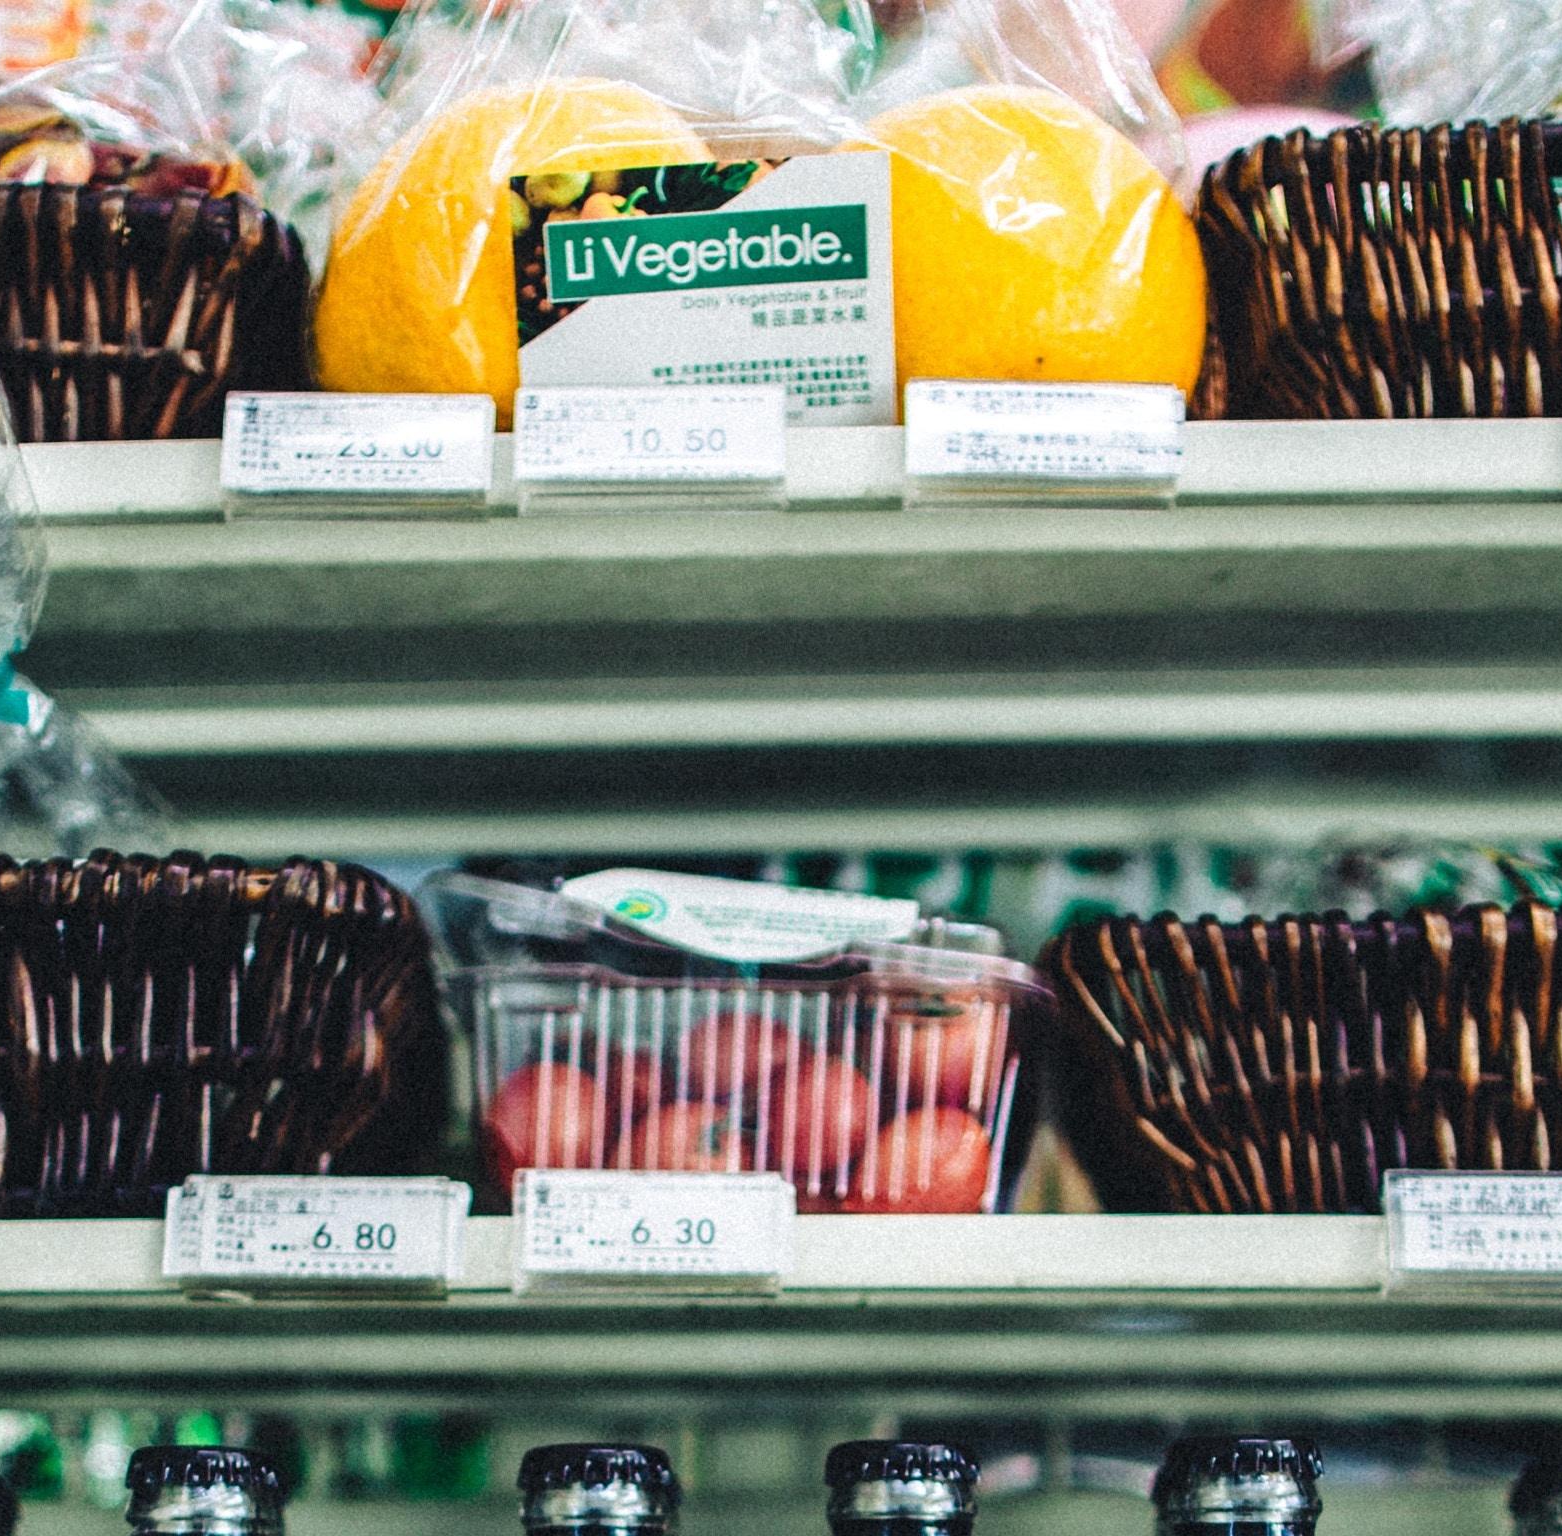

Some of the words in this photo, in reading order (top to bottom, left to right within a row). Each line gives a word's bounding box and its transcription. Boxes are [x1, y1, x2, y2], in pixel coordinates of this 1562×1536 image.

[728, 287, 811, 307] Vegetable
[312, 1221, 397, 1251] 6.80
[631, 1217, 716, 1246] 6.30
